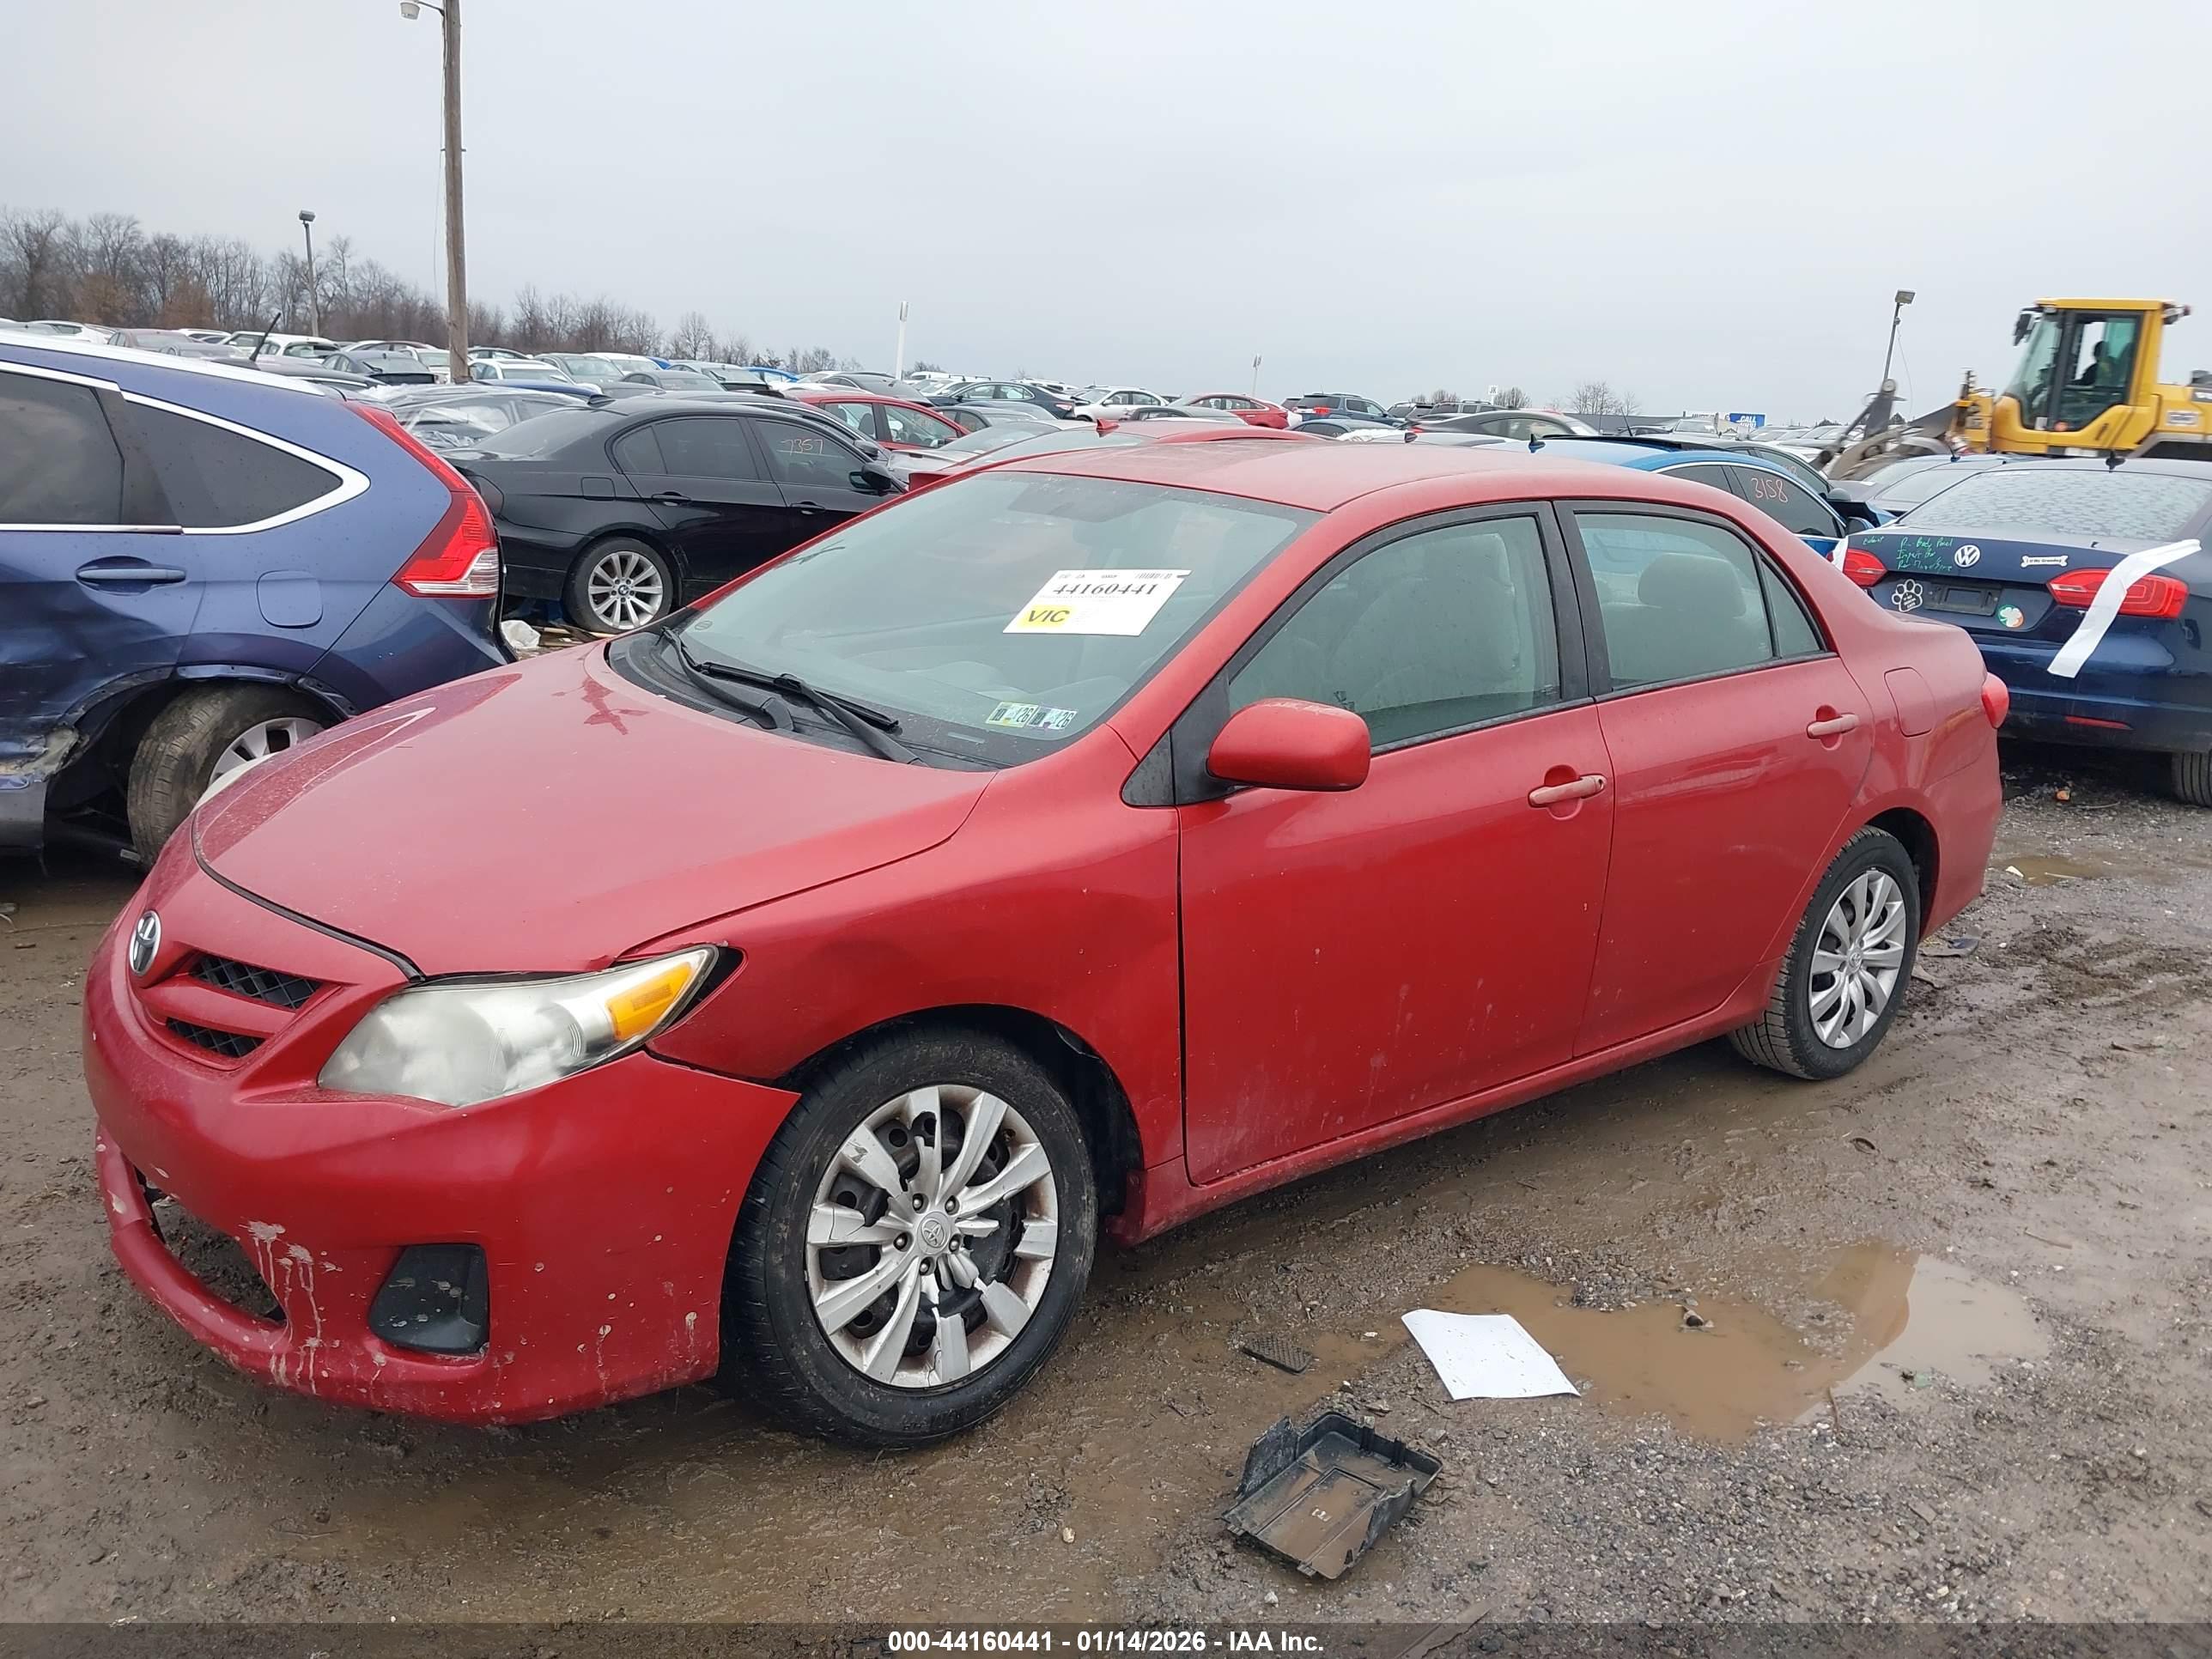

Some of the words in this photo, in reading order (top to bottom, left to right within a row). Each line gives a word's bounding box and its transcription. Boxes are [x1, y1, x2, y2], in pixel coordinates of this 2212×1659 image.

[1739, 415, 1757, 423] CALL
[1751, 477, 1789, 502] 3158
[1054, 583, 1158, 595] 44160441
[1028, 610, 1071, 623] VIC
